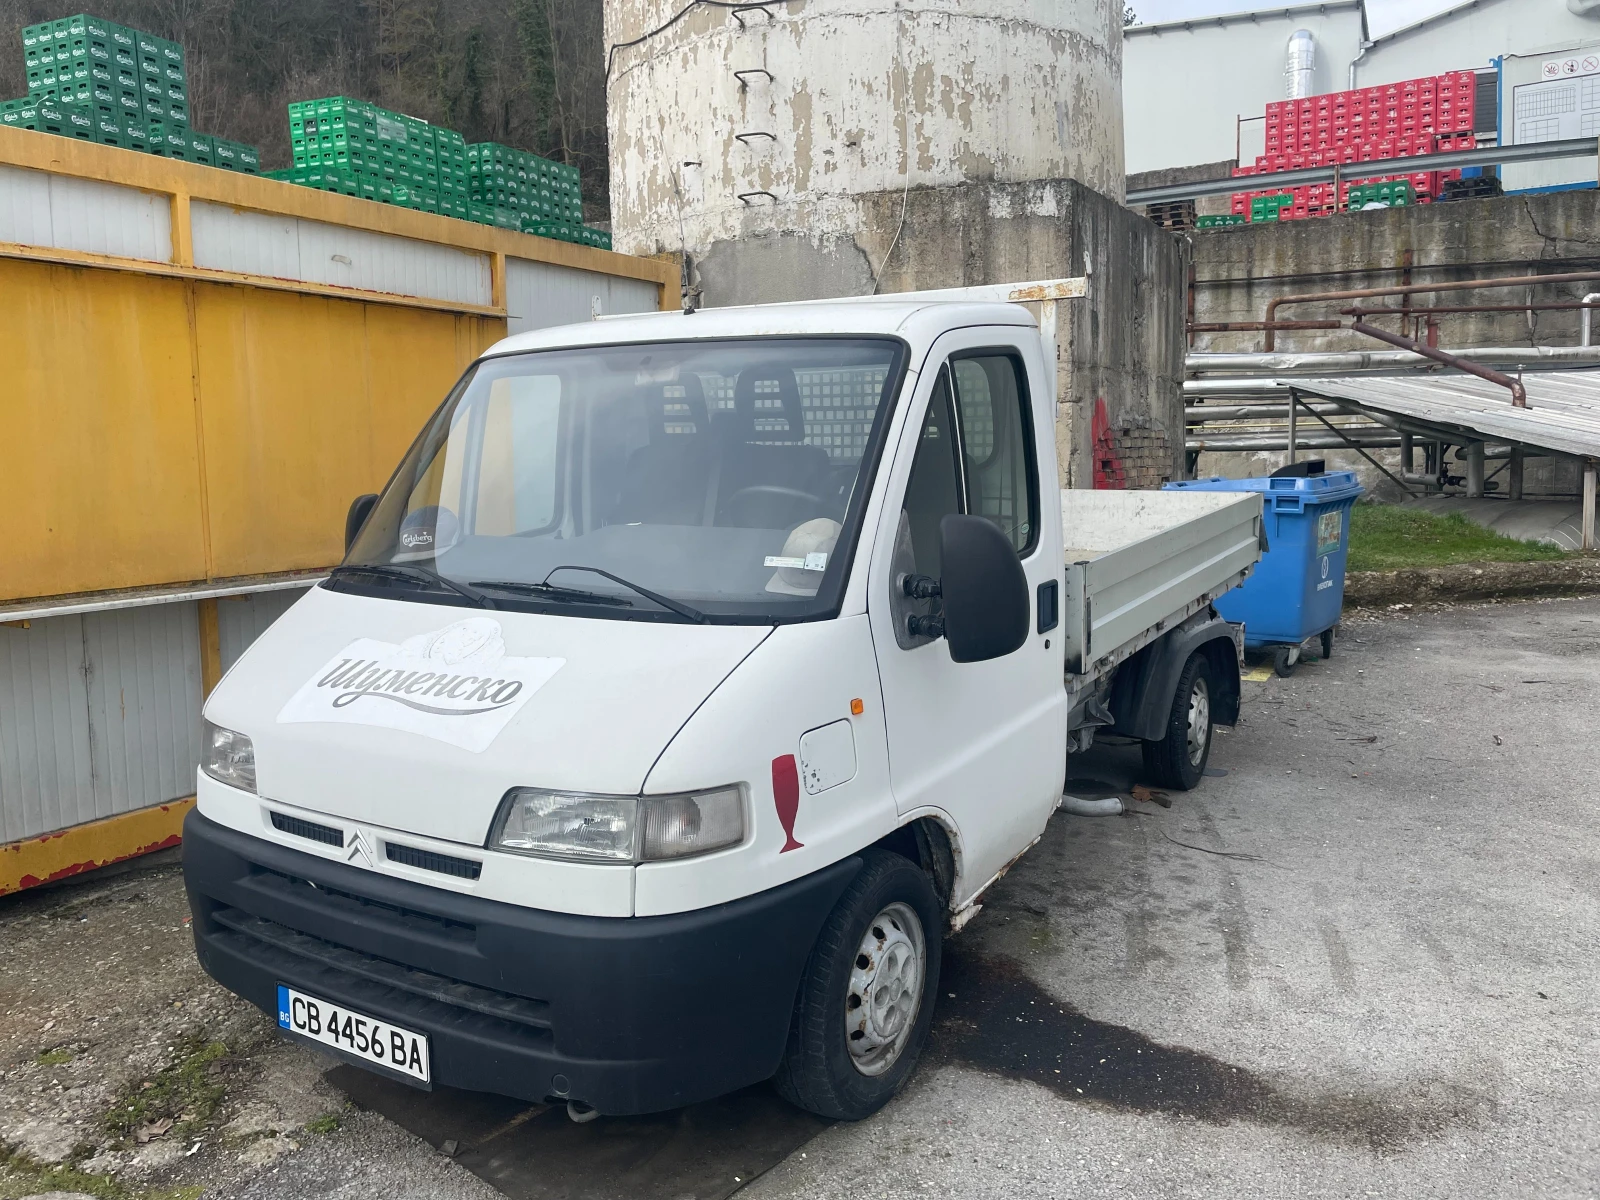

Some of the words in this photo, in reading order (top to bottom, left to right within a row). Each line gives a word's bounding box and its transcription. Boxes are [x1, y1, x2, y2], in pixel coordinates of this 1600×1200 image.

[402, 531, 433, 548] Carlsberg
[317, 658, 523, 712] Шуменско
[279, 1010, 290, 1023] BG
[292, 996, 322, 1036] CB
[327, 1011, 385, 1059] 4456
[390, 1030, 424, 1075] BA
